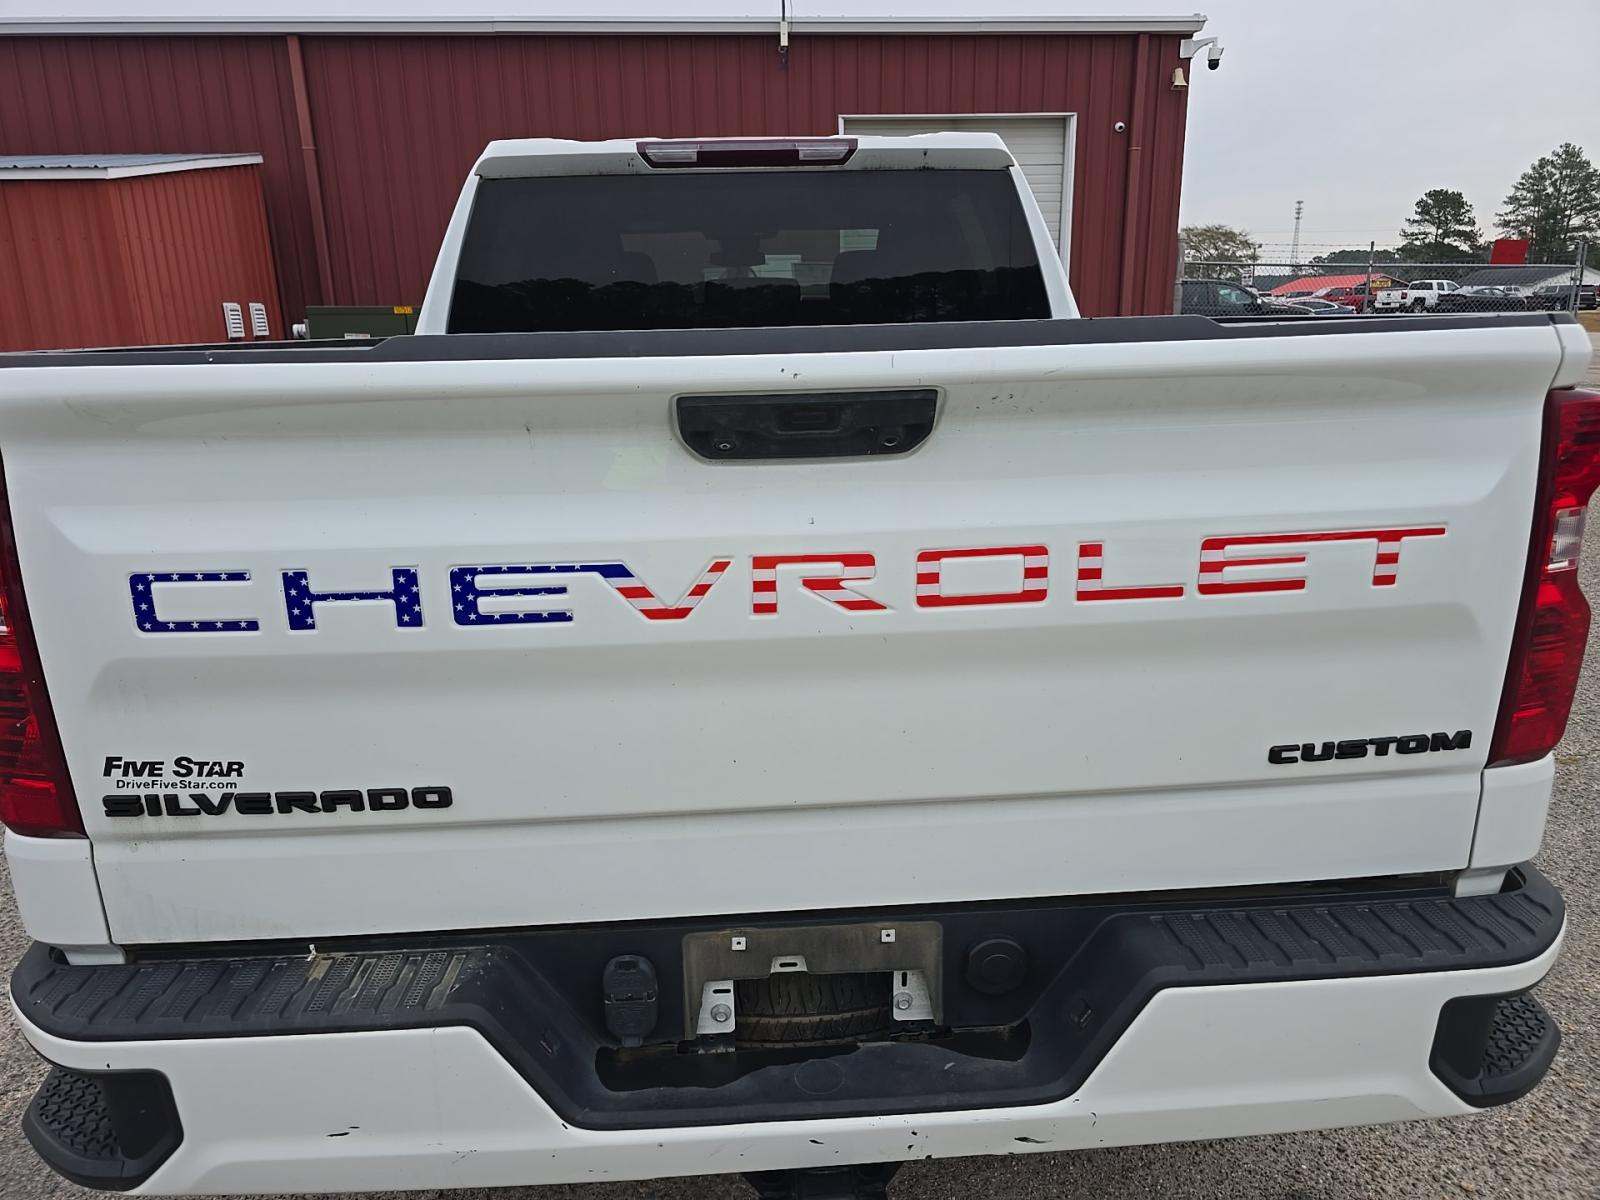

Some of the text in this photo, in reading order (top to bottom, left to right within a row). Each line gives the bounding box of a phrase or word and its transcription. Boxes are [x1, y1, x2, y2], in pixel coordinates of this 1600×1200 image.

[129, 526, 1446, 633] CHEVROLET
[1268, 729, 1473, 764] CUSTOM
[116, 779, 238, 789] DriveFiveStar.com
[102, 785, 453, 818] SILVERADO
